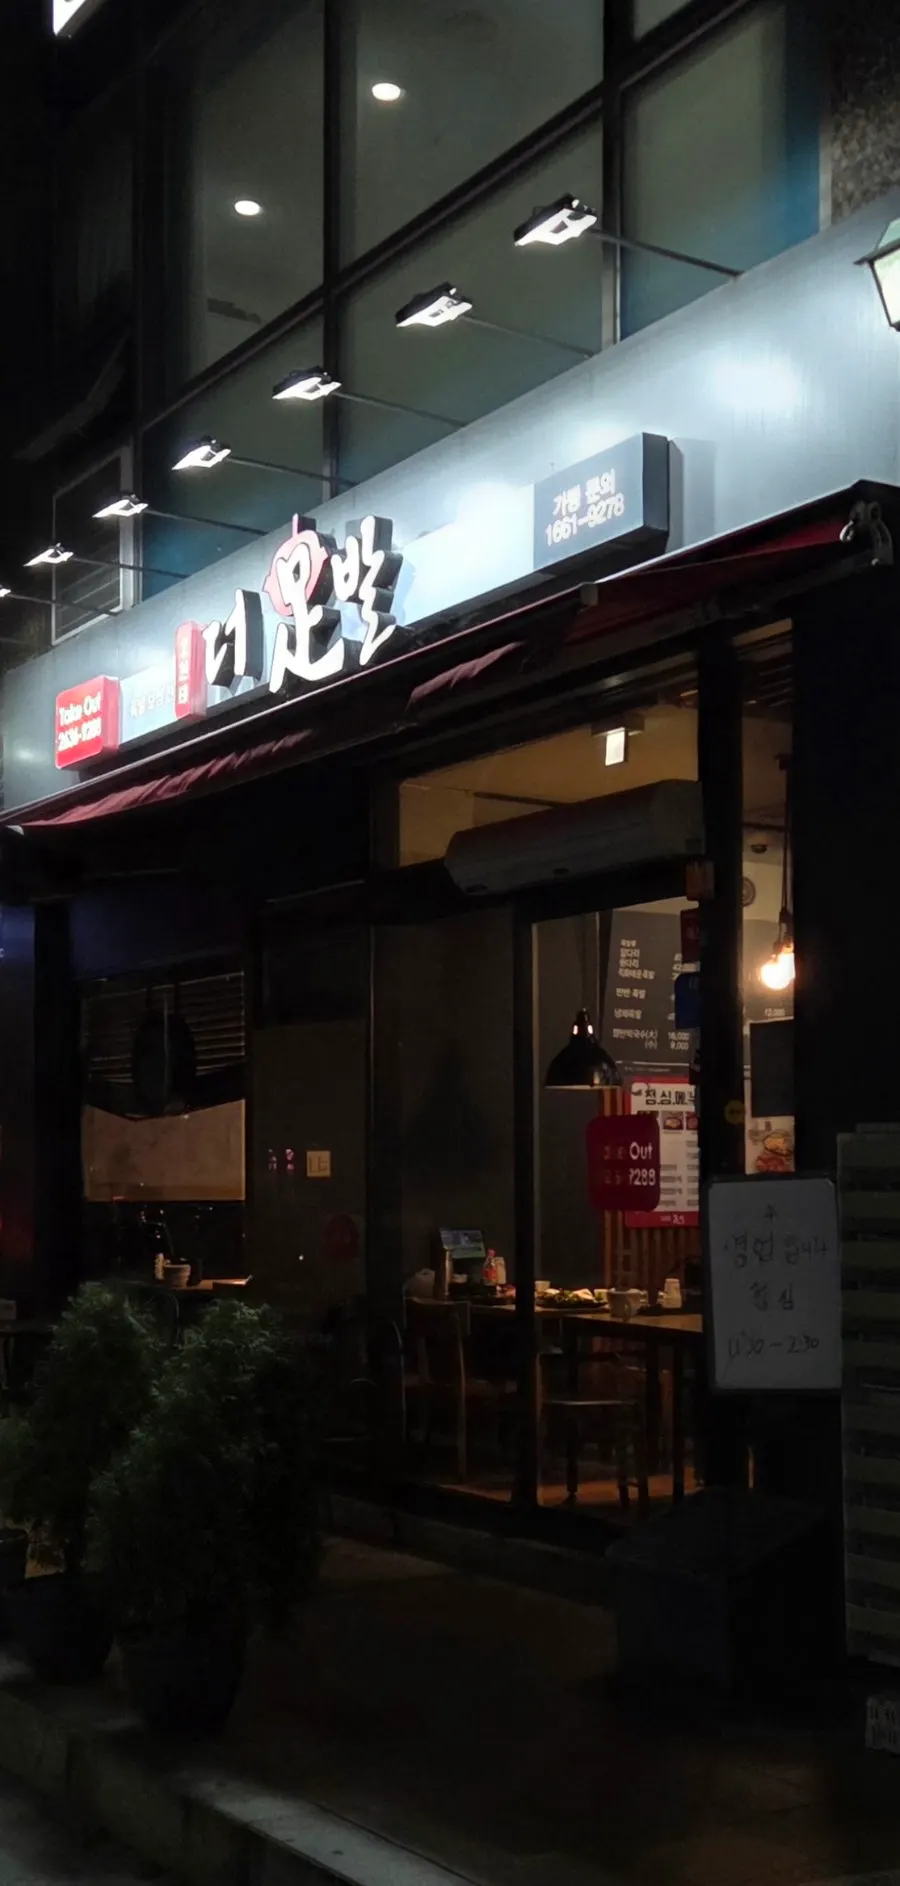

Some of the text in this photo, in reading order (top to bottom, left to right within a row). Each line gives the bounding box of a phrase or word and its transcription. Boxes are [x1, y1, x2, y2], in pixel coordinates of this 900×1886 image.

[545, 492, 625, 546] 1661-9278
[58, 691, 101, 726] Take Out
[628, 1140, 653, 1160] Out
